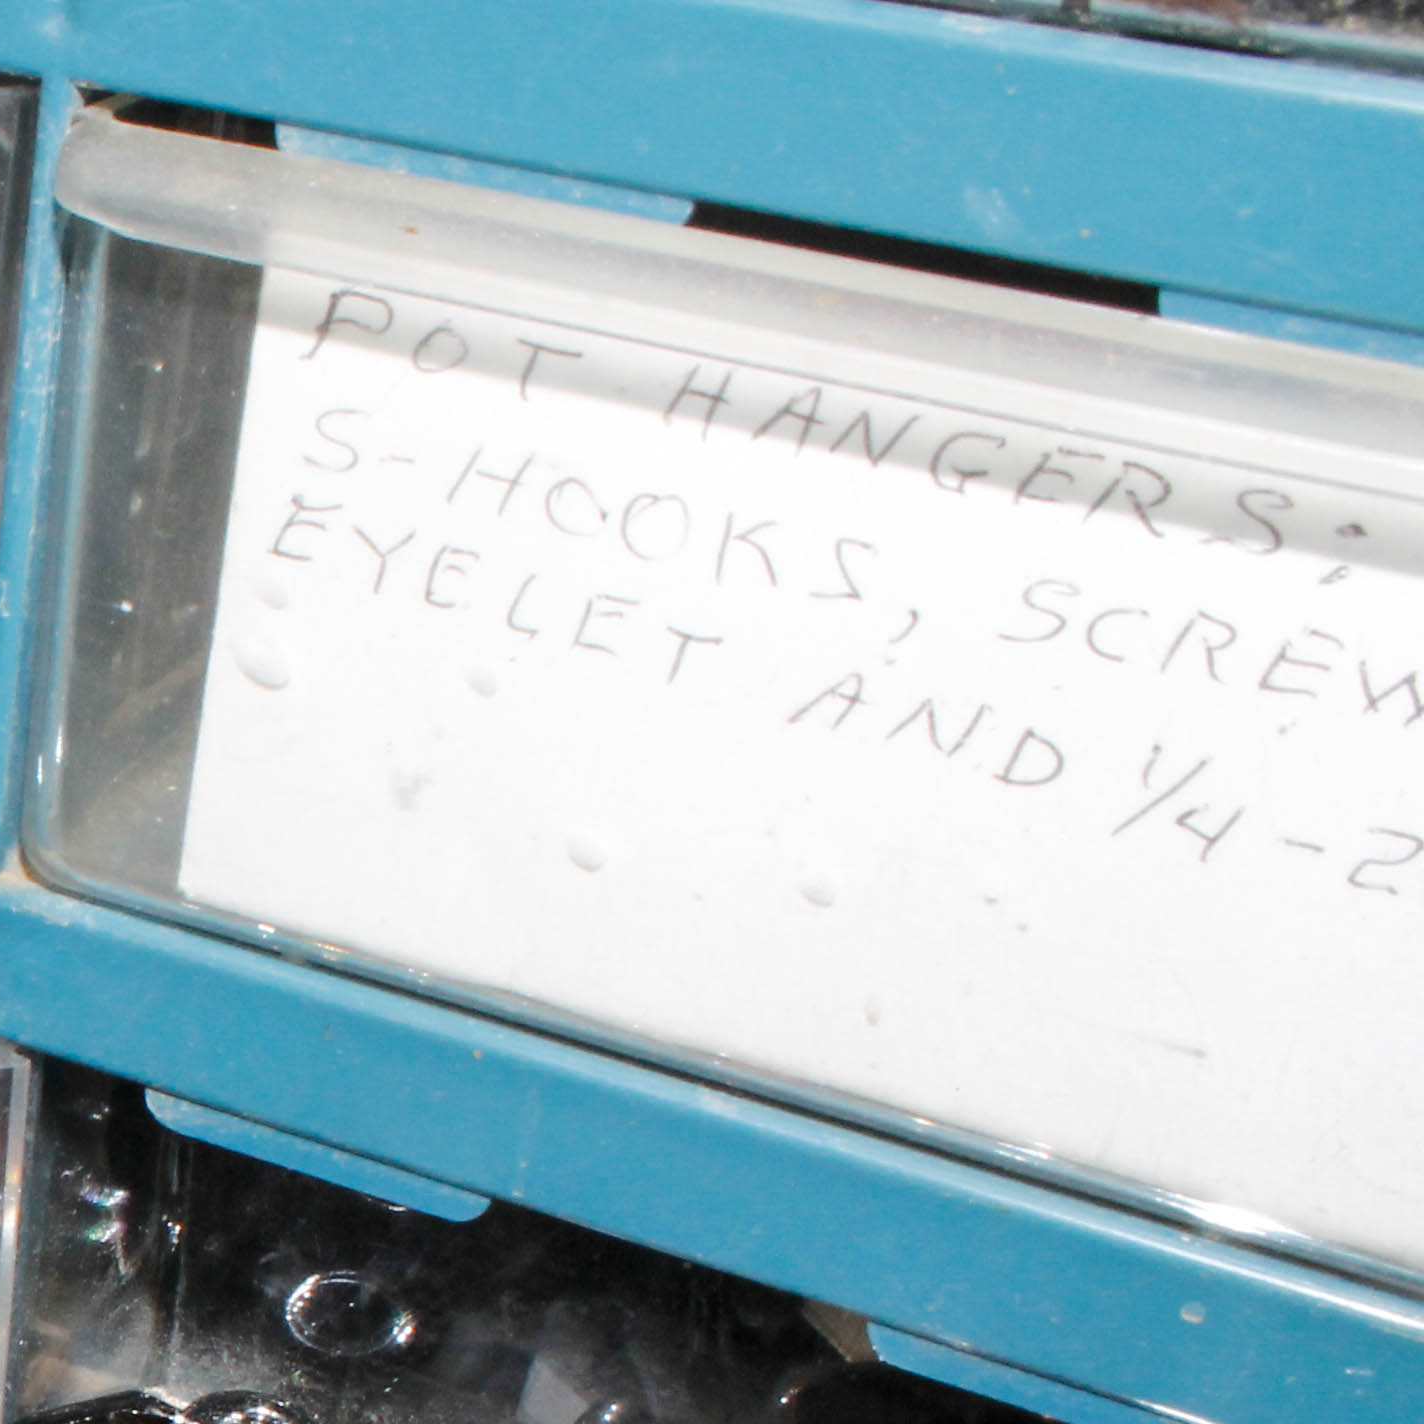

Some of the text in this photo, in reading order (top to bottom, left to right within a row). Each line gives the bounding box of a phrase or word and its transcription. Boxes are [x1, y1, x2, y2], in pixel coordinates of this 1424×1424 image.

[298, 289, 583, 401] POT
[268, 494, 724, 686] EYELET
[787, 672, 1064, 787] AND
